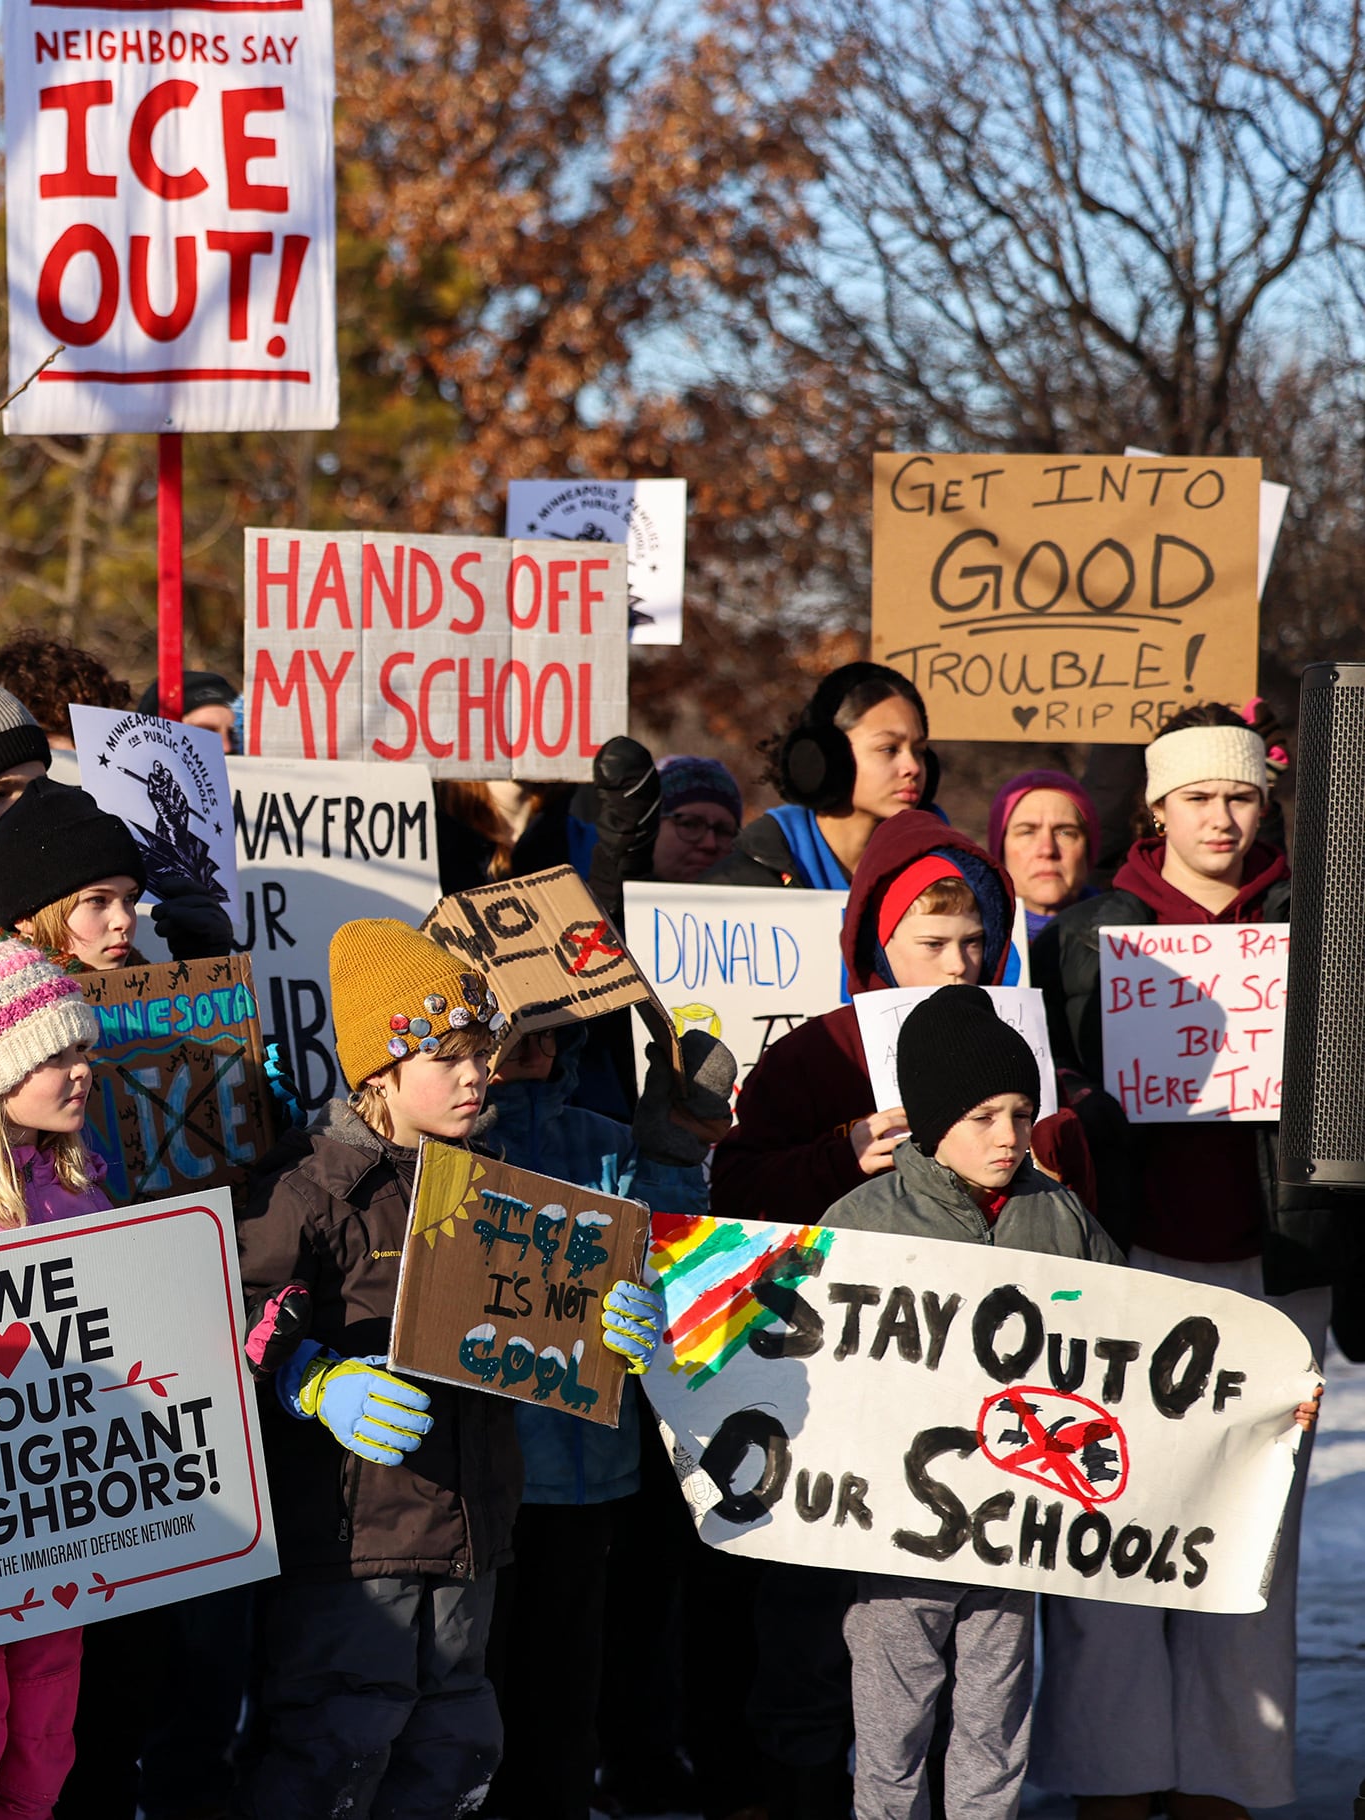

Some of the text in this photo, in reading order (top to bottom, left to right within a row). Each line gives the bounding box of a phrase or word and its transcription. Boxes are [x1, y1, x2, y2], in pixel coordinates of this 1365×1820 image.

[35, 30, 298, 64] NEIGHBORS SAY
[39, 79, 290, 213] ICE
[37, 223, 311, 359] OUT!
[538, 484, 619, 521] MINNEAPOLIS
[580, 499, 620, 516] PUBLIC
[890, 456, 1225, 517] GET INTO
[256, 537, 610, 635] HANDS OFF
[930, 528, 1216, 614] GOOD
[885, 633, 1207, 697] TROUBLE!
[248, 649, 606, 762] MY SCHOOL
[1045, 701, 1114, 729] RIP
[105, 713, 219, 807] MINNEAPOLIS FAMILIES
[127, 730, 211, 815] FOR PUBLIC SCHOOLS
[322, 796, 427, 861] FROM
[654, 907, 800, 990] DONALD
[1106, 931, 1212, 961] WOULD
[1106, 974, 1287, 1014] BE IN SC
[1176, 1025, 1274, 1058] BUT
[1117, 1057, 1203, 1116] HERE
[473, 1188, 614, 1280] ICE
[483, 1272, 599, 1323] IS NOT
[747, 1244, 1247, 1420] STAY OUT OF
[457, 1322, 600, 1414] COOL
[698, 1406, 1216, 1589] OUR SCHOOLS
[21, 1539, 89, 1572] IMMIGRANT
[90, 1527, 140, 1555] DEFENSE
[141, 1513, 196, 1544] NETWORK
